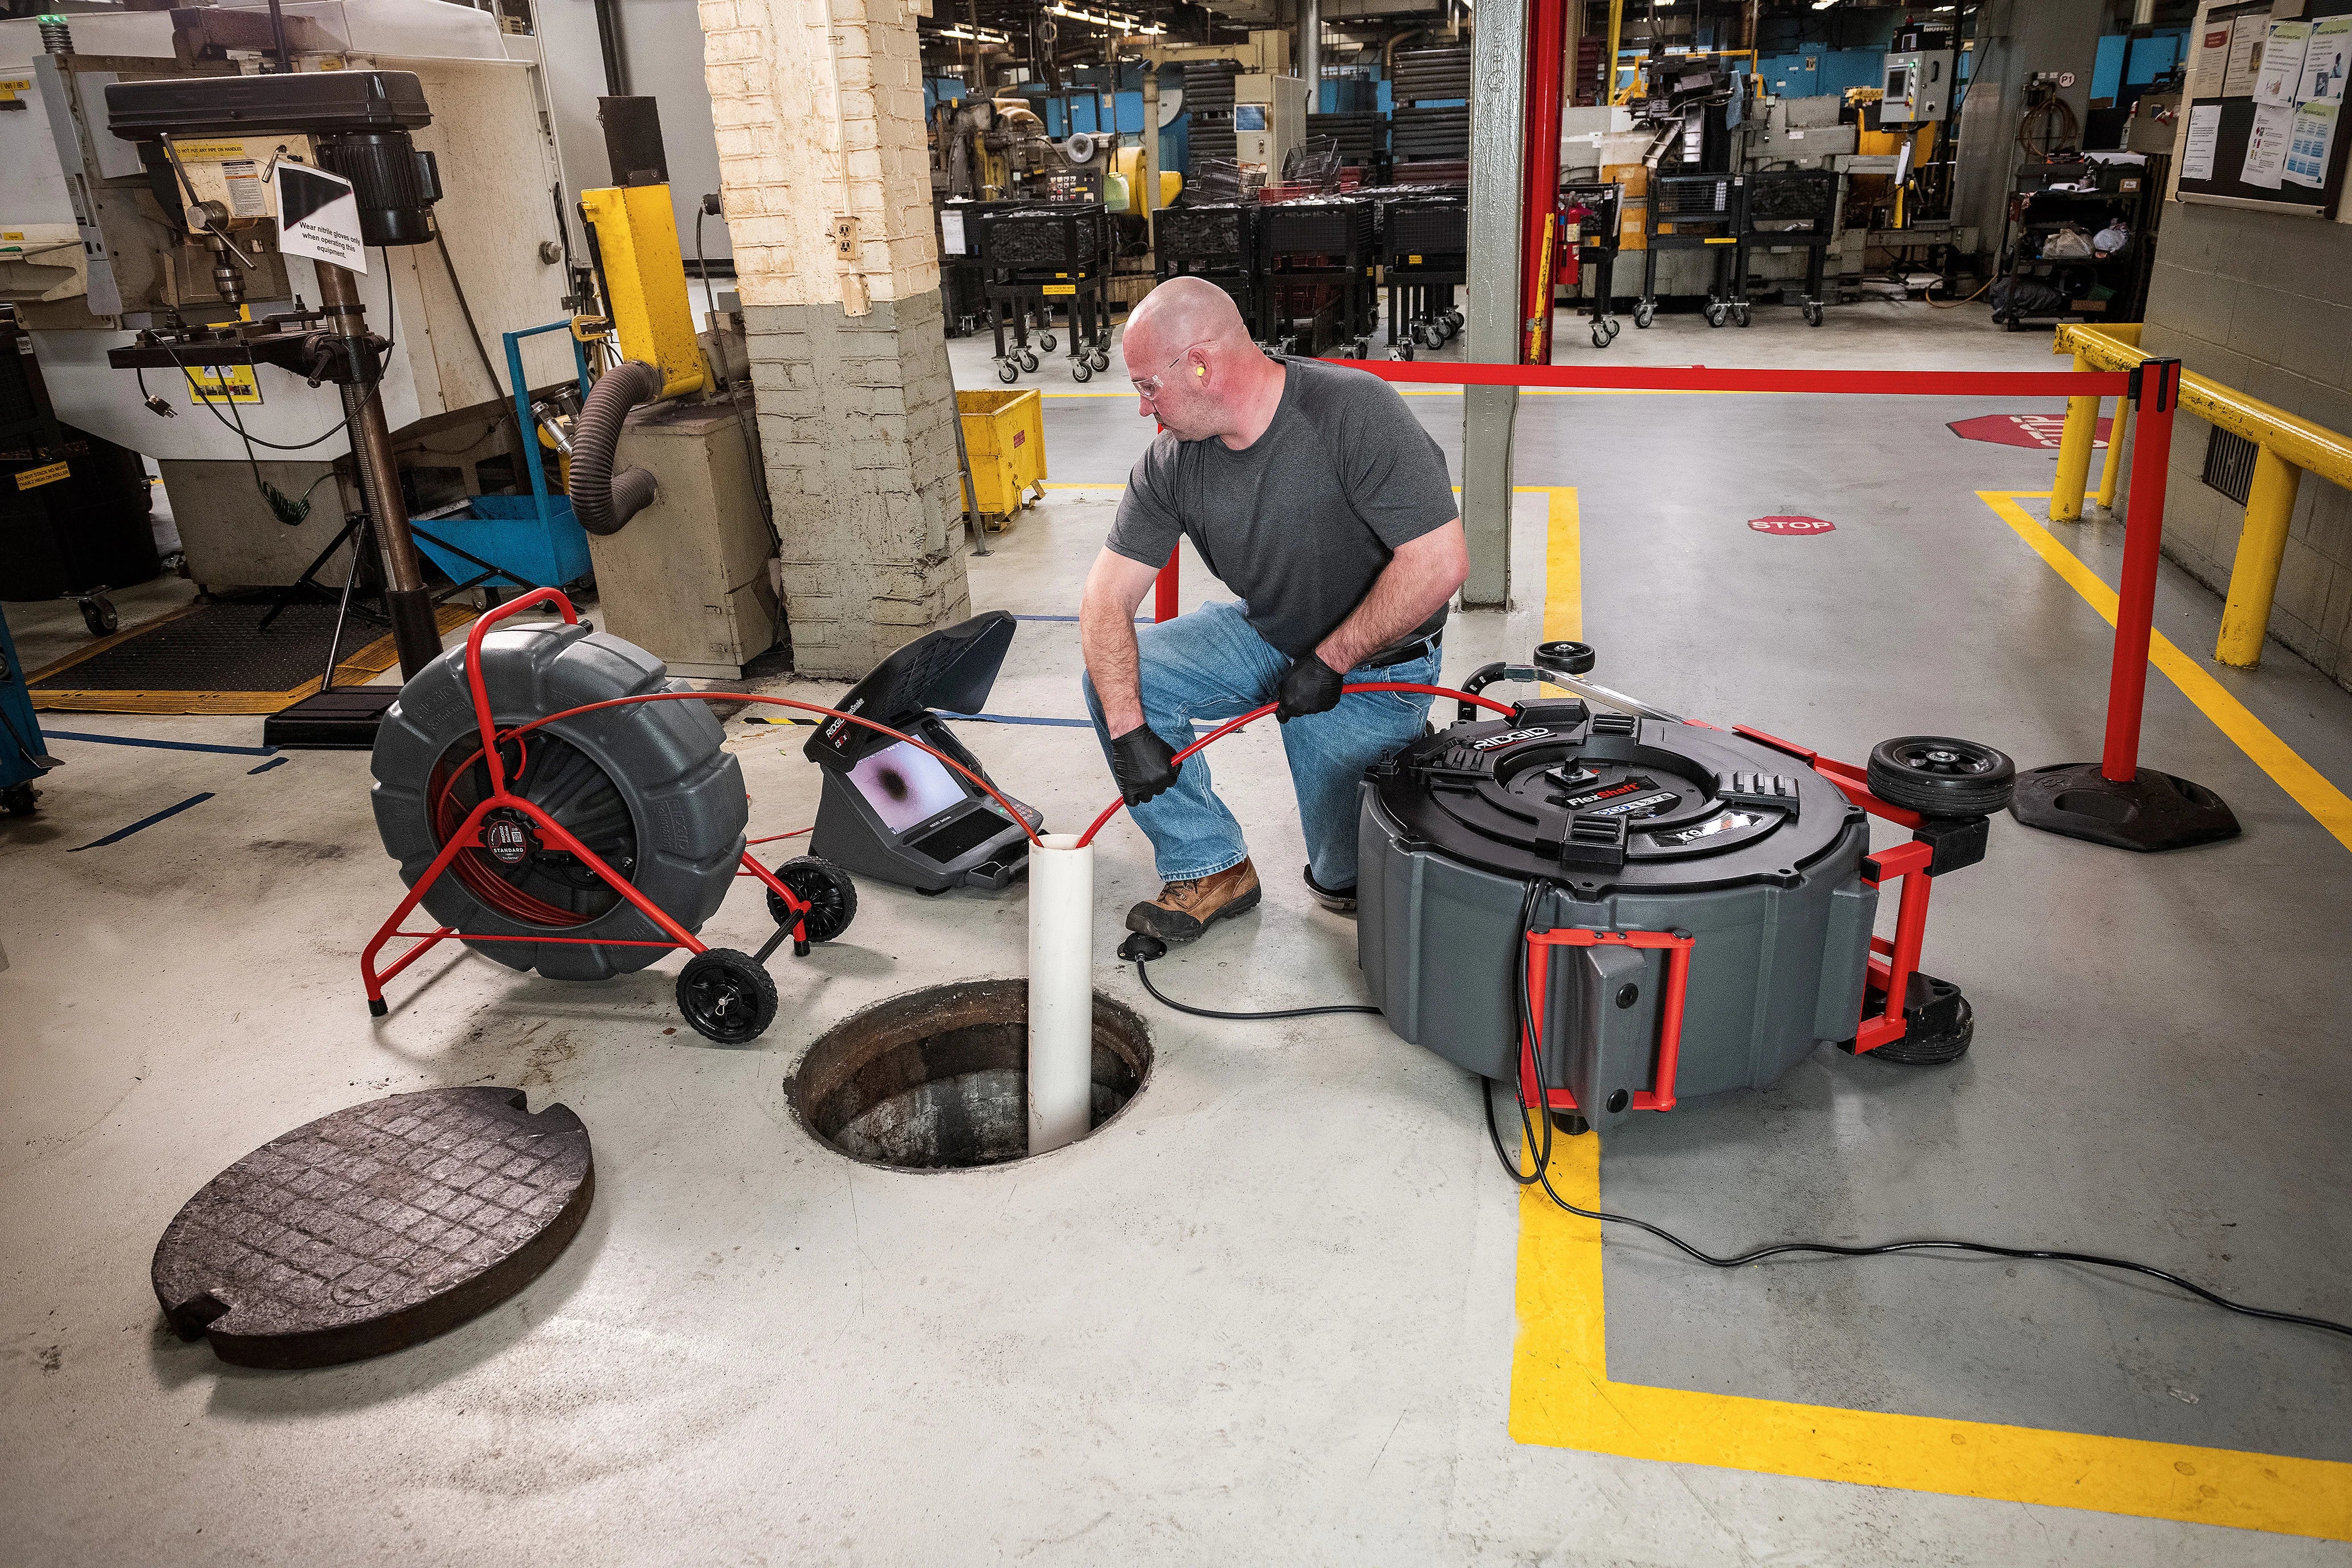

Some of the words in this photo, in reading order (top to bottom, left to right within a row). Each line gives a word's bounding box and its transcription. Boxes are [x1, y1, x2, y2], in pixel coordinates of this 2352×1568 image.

[299, 222, 316, 231] Wear
[317, 226, 333, 235] nitrile
[333, 231, 349, 241] gloves
[350, 236, 360, 246] only
[302, 232, 320, 241] when
[321, 237, 345, 250] operating
[346, 243, 356, 252] this
[52, 470, 68, 479] ROLLER
[1473, 728, 1549, 749] RIDGID
